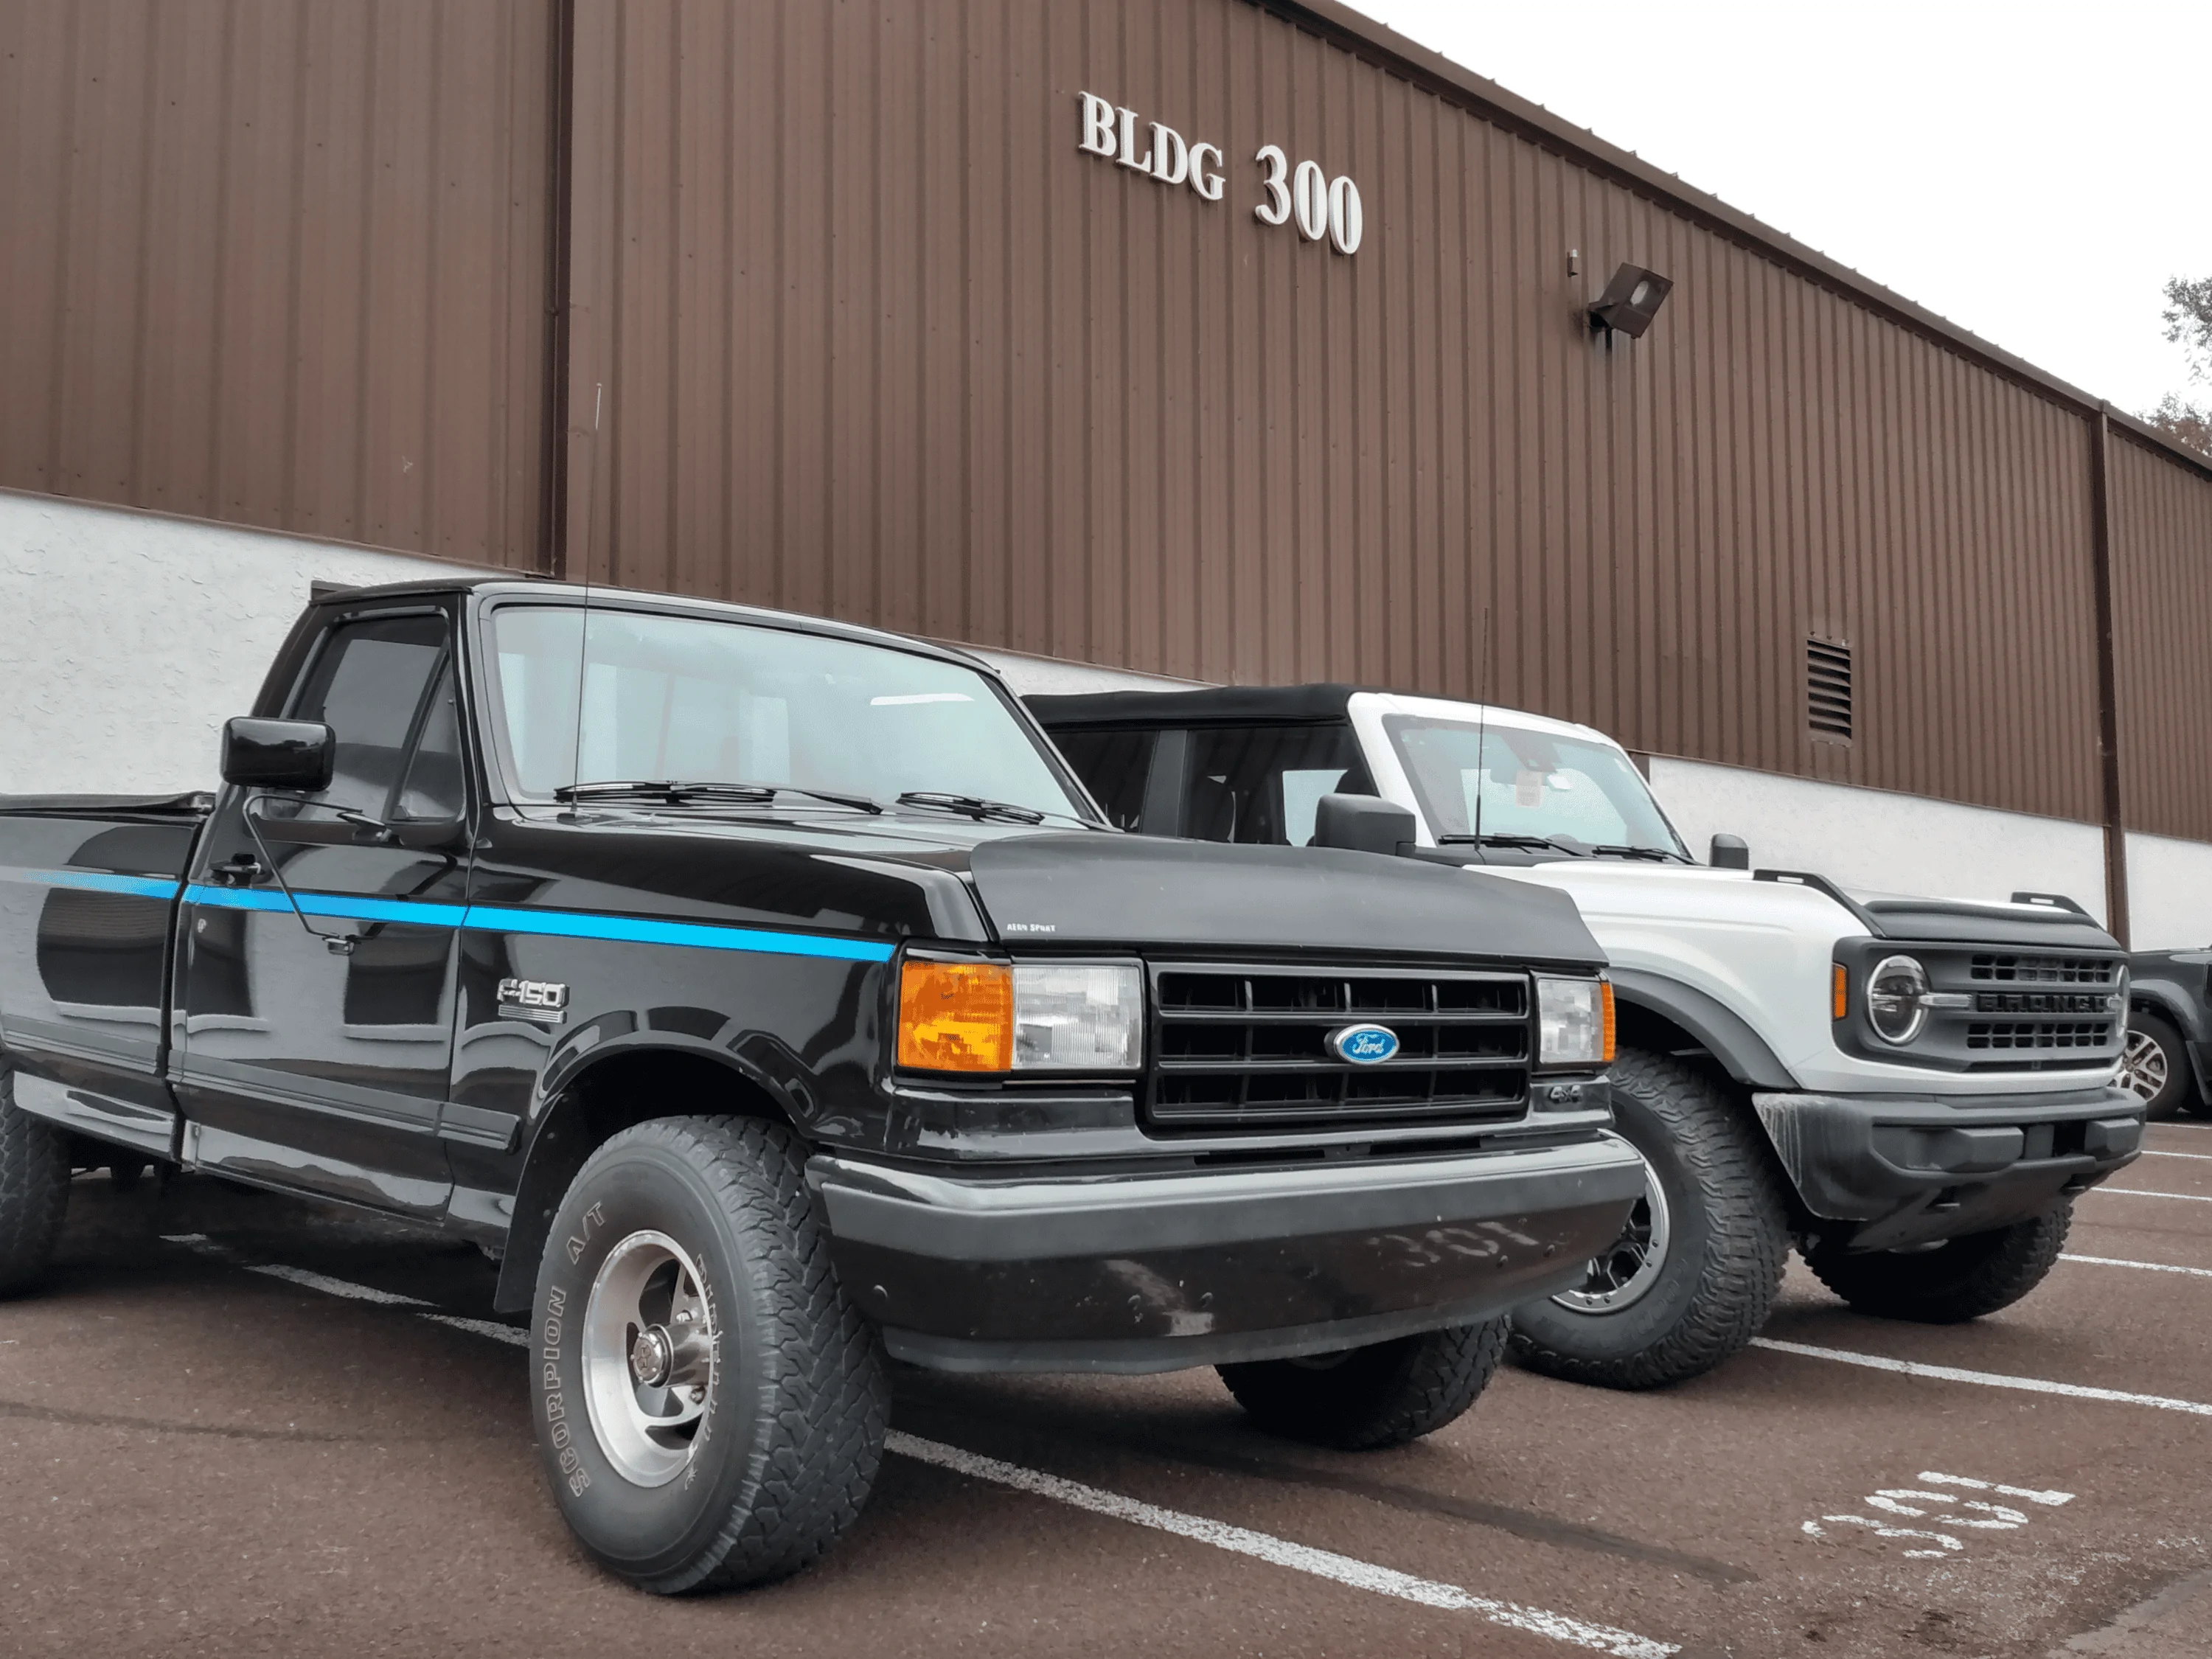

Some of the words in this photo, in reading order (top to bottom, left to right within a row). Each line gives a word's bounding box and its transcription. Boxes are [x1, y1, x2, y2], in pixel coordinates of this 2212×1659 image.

[1079, 91, 1225, 201] BLDG
[1255, 145, 1363, 255] 300
[1006, 923, 1028, 931] AERO
[1029, 923, 1056, 932] SPORT
[496, 978, 566, 1007] F-150
[1352, 1033, 1385, 1054] Ford
[566, 1201, 605, 1265] A/T
[543, 1285, 591, 1498] SCORPION
